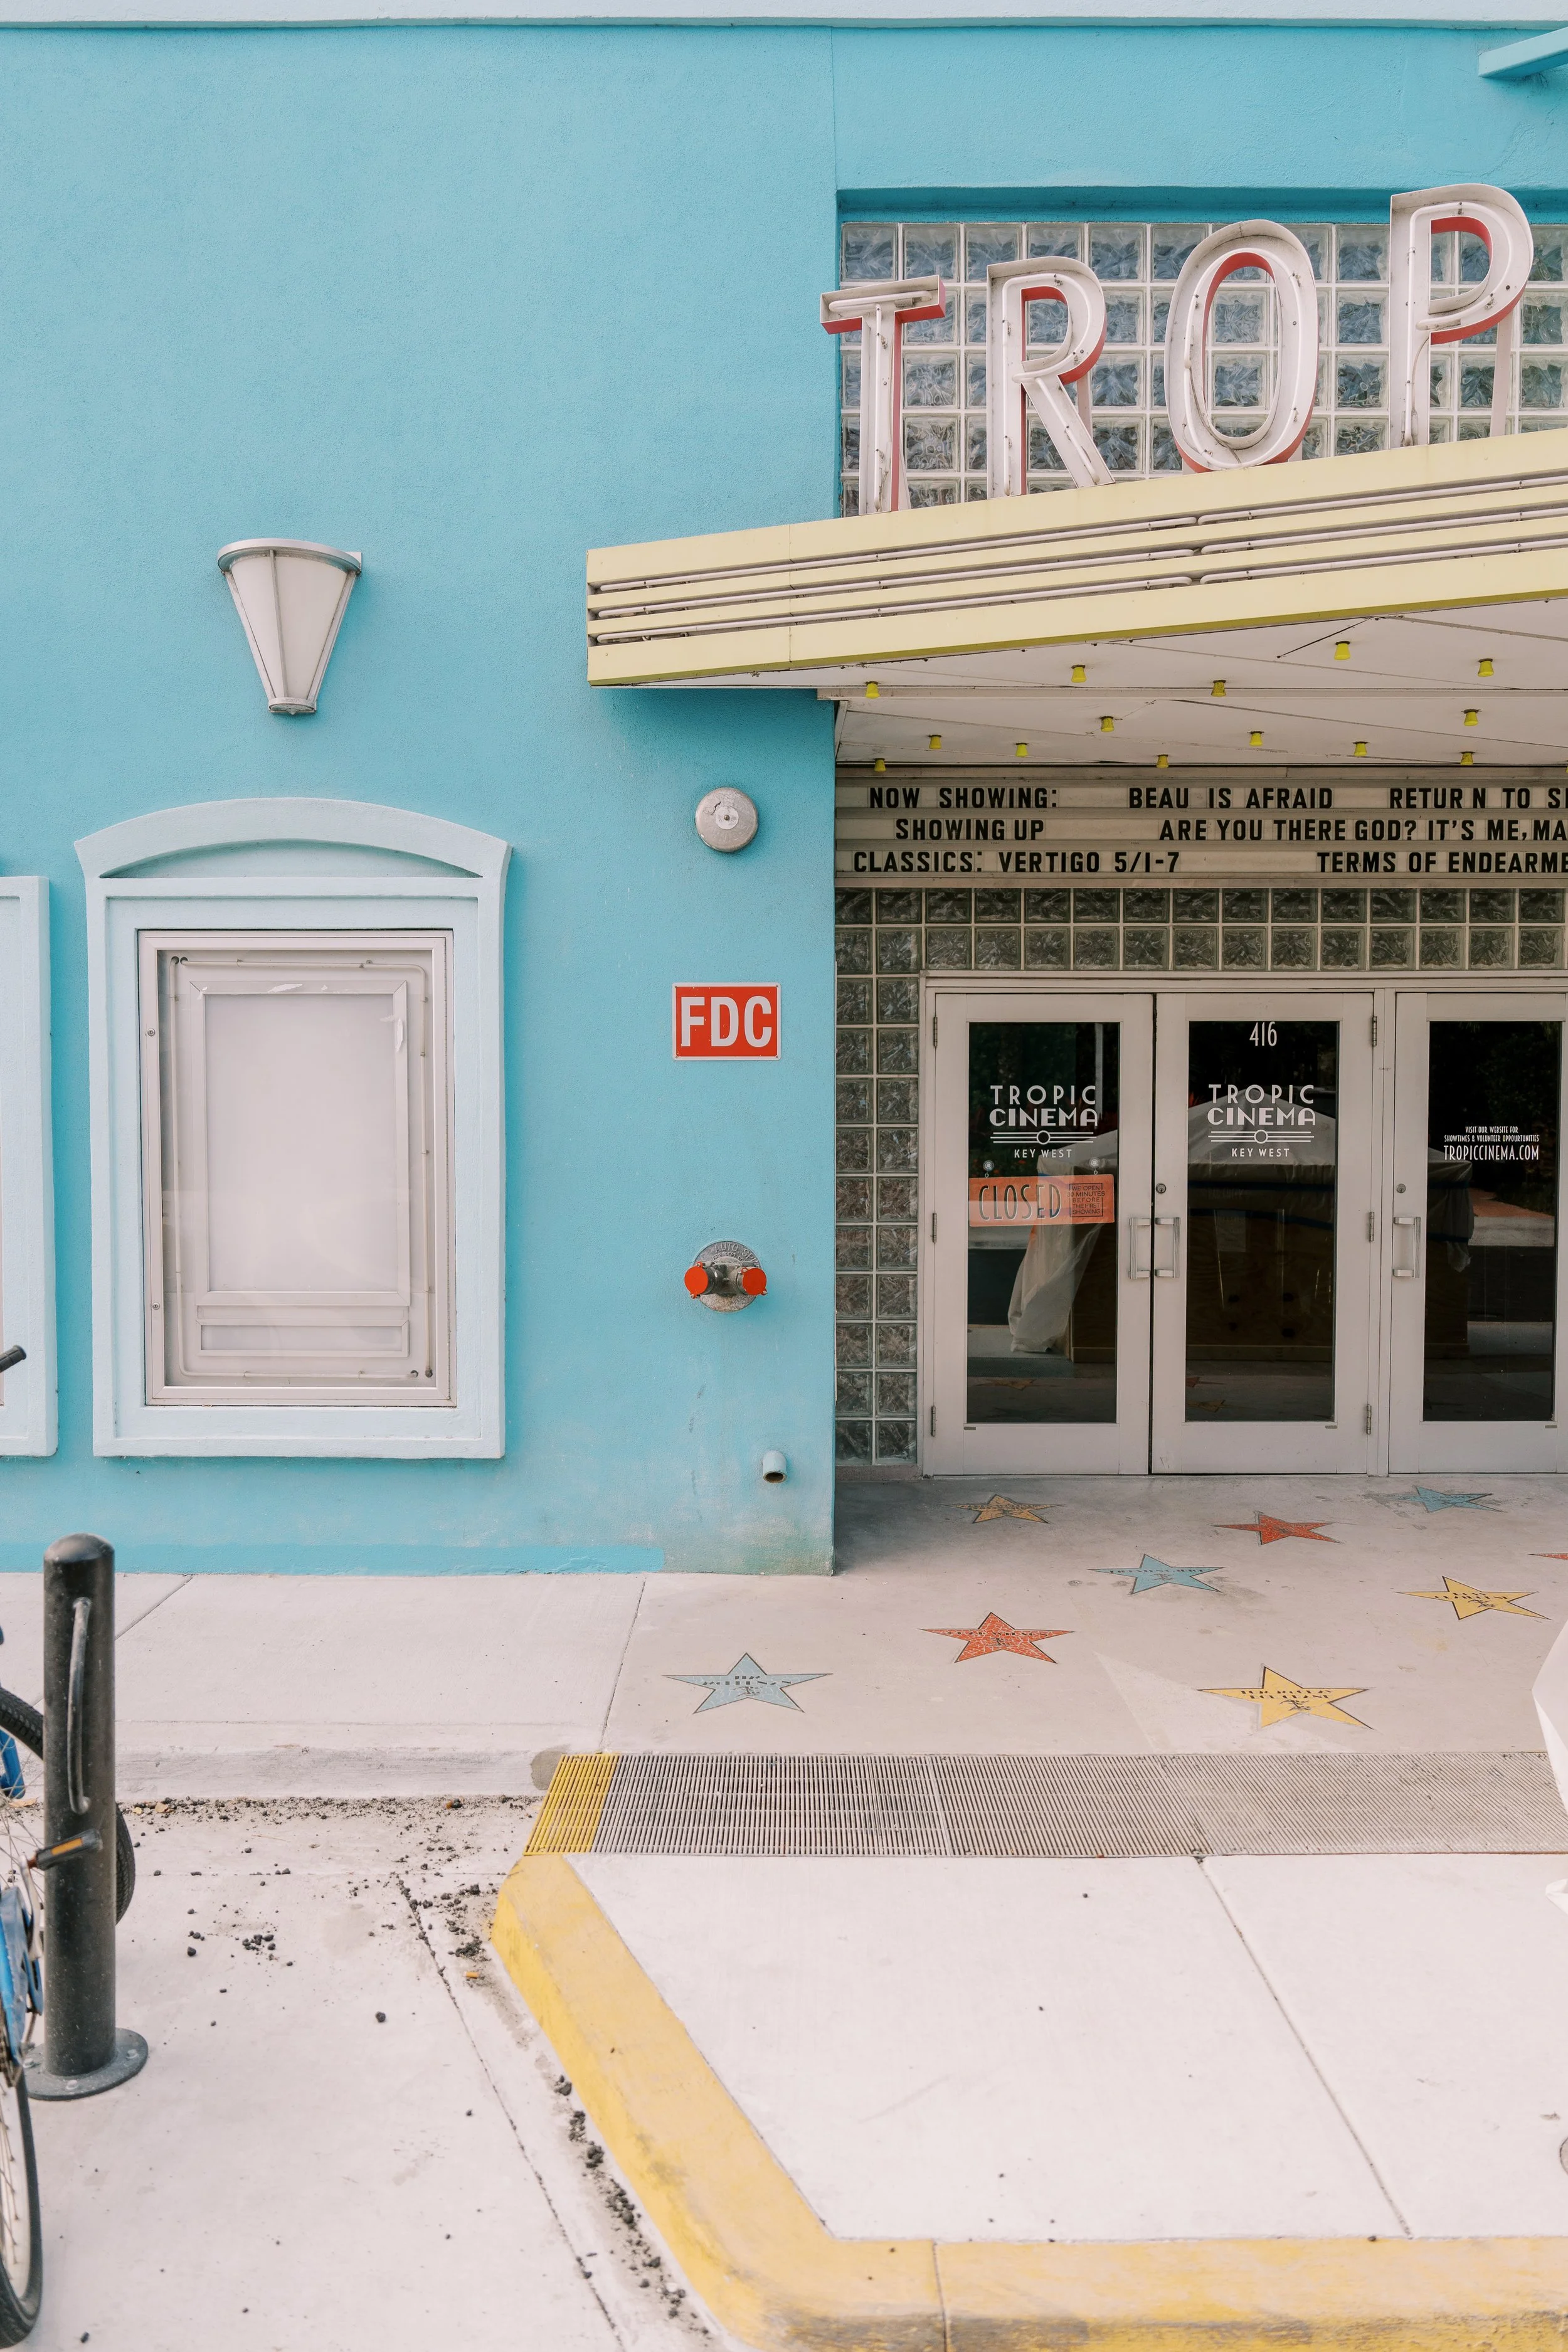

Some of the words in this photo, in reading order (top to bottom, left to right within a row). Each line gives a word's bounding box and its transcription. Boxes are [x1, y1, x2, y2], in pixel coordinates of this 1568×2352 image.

[821, 183, 1534, 515] TROP
[869, 787, 921, 808] NOW
[939, 787, 1057, 808] SHOWING:
[1129, 787, 1189, 808] BEAU
[1209, 787, 1231, 808] IS
[1246, 787, 1333, 808] AFRAID
[1502, 788, 1530, 808] TO
[1547, 788, 1568, 808] S
[896, 818, 1005, 840] SHOWING
[1014, 819, 1044, 840] UP
[1159, 819, 1207, 840] ARE
[1216, 819, 1263, 840] YOU
[1273, 818, 1345, 840] THERE
[1355, 819, 1416, 840] GOD?
[1428, 820, 1474, 840] IT'S
[854, 851, 982, 872] CLASSICS:
[998, 852, 1099, 872] VERTIGO
[1115, 852, 1179, 872] 5/1-7
[1317, 851, 1396, 872] TERMS
[1409, 852, 1436, 872] OF
[681, 996, 772, 1047] FDC
[1249, 1022, 1277, 1046] 416
[990, 1085, 1096, 1104] TROPIC
[1208, 1084, 1315, 1104] TROPIC
[989, 1107, 1098, 1127] CINEMA
[1207, 1106, 1316, 1126] CINEMA
[1014, 1148, 1036, 1158] KEY
[1041, 1148, 1072, 1158] WEST
[1231, 1148, 1254, 1157] KEY
[1258, 1148, 1290, 1157] WEST
[1443, 1145, 1539, 1160] TROPICCINEMA.COM
[978, 1184, 1062, 1221] CLOSED
